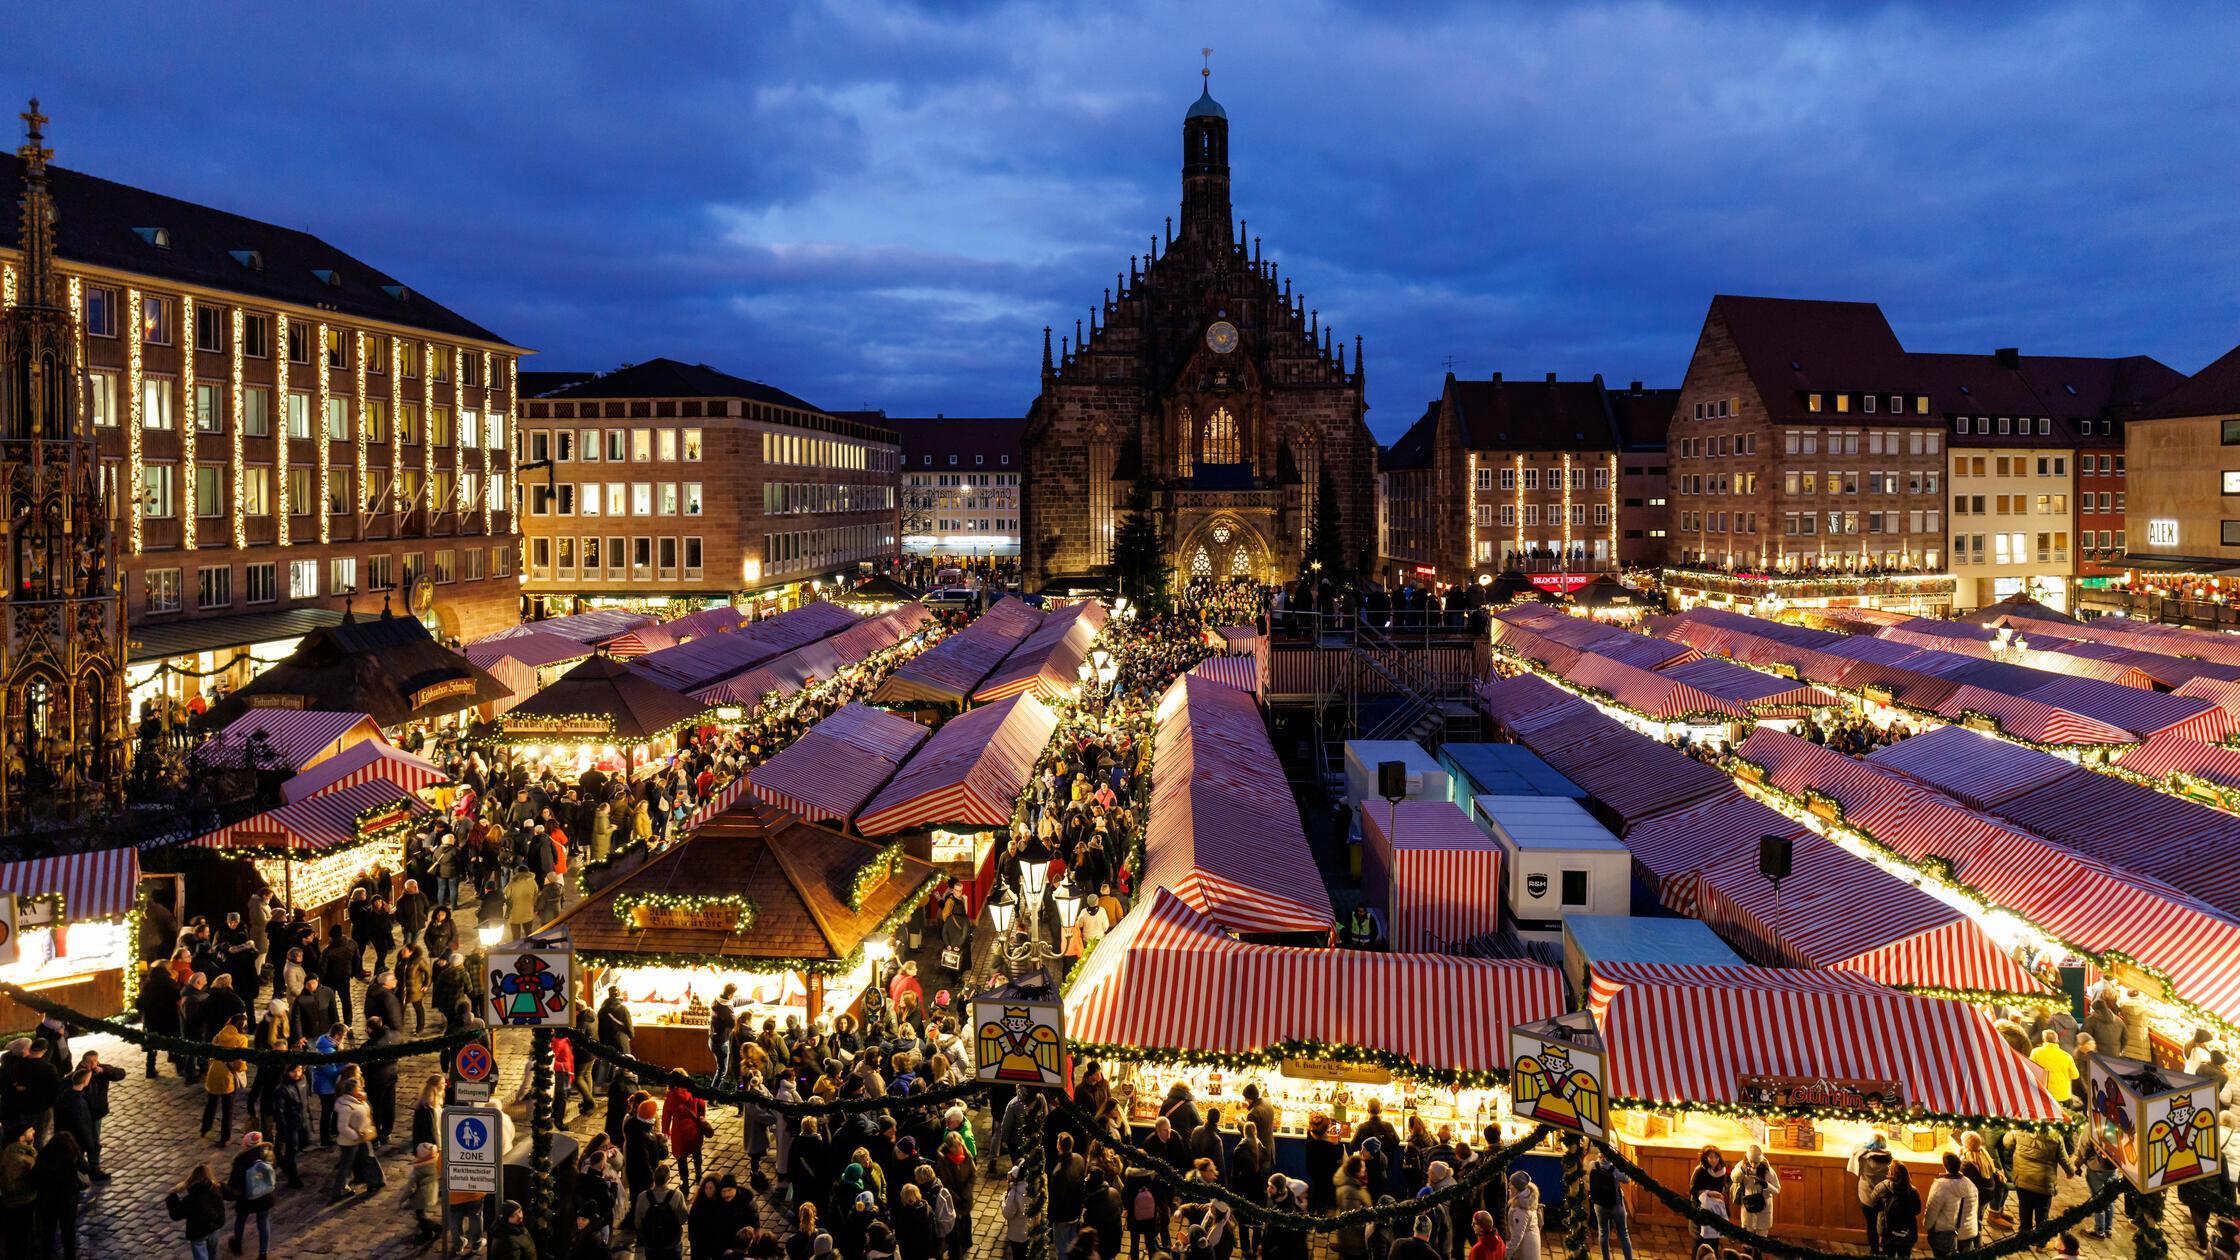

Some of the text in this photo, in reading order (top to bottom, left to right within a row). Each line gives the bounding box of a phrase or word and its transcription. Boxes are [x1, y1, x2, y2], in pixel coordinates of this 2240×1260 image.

[2149, 522, 2175, 543] ALEX
[420, 686, 448, 703] Lebkuchen
[458, 1088, 487, 1097] Rettungsweg
[460, 1152, 484, 1160] ZONE
